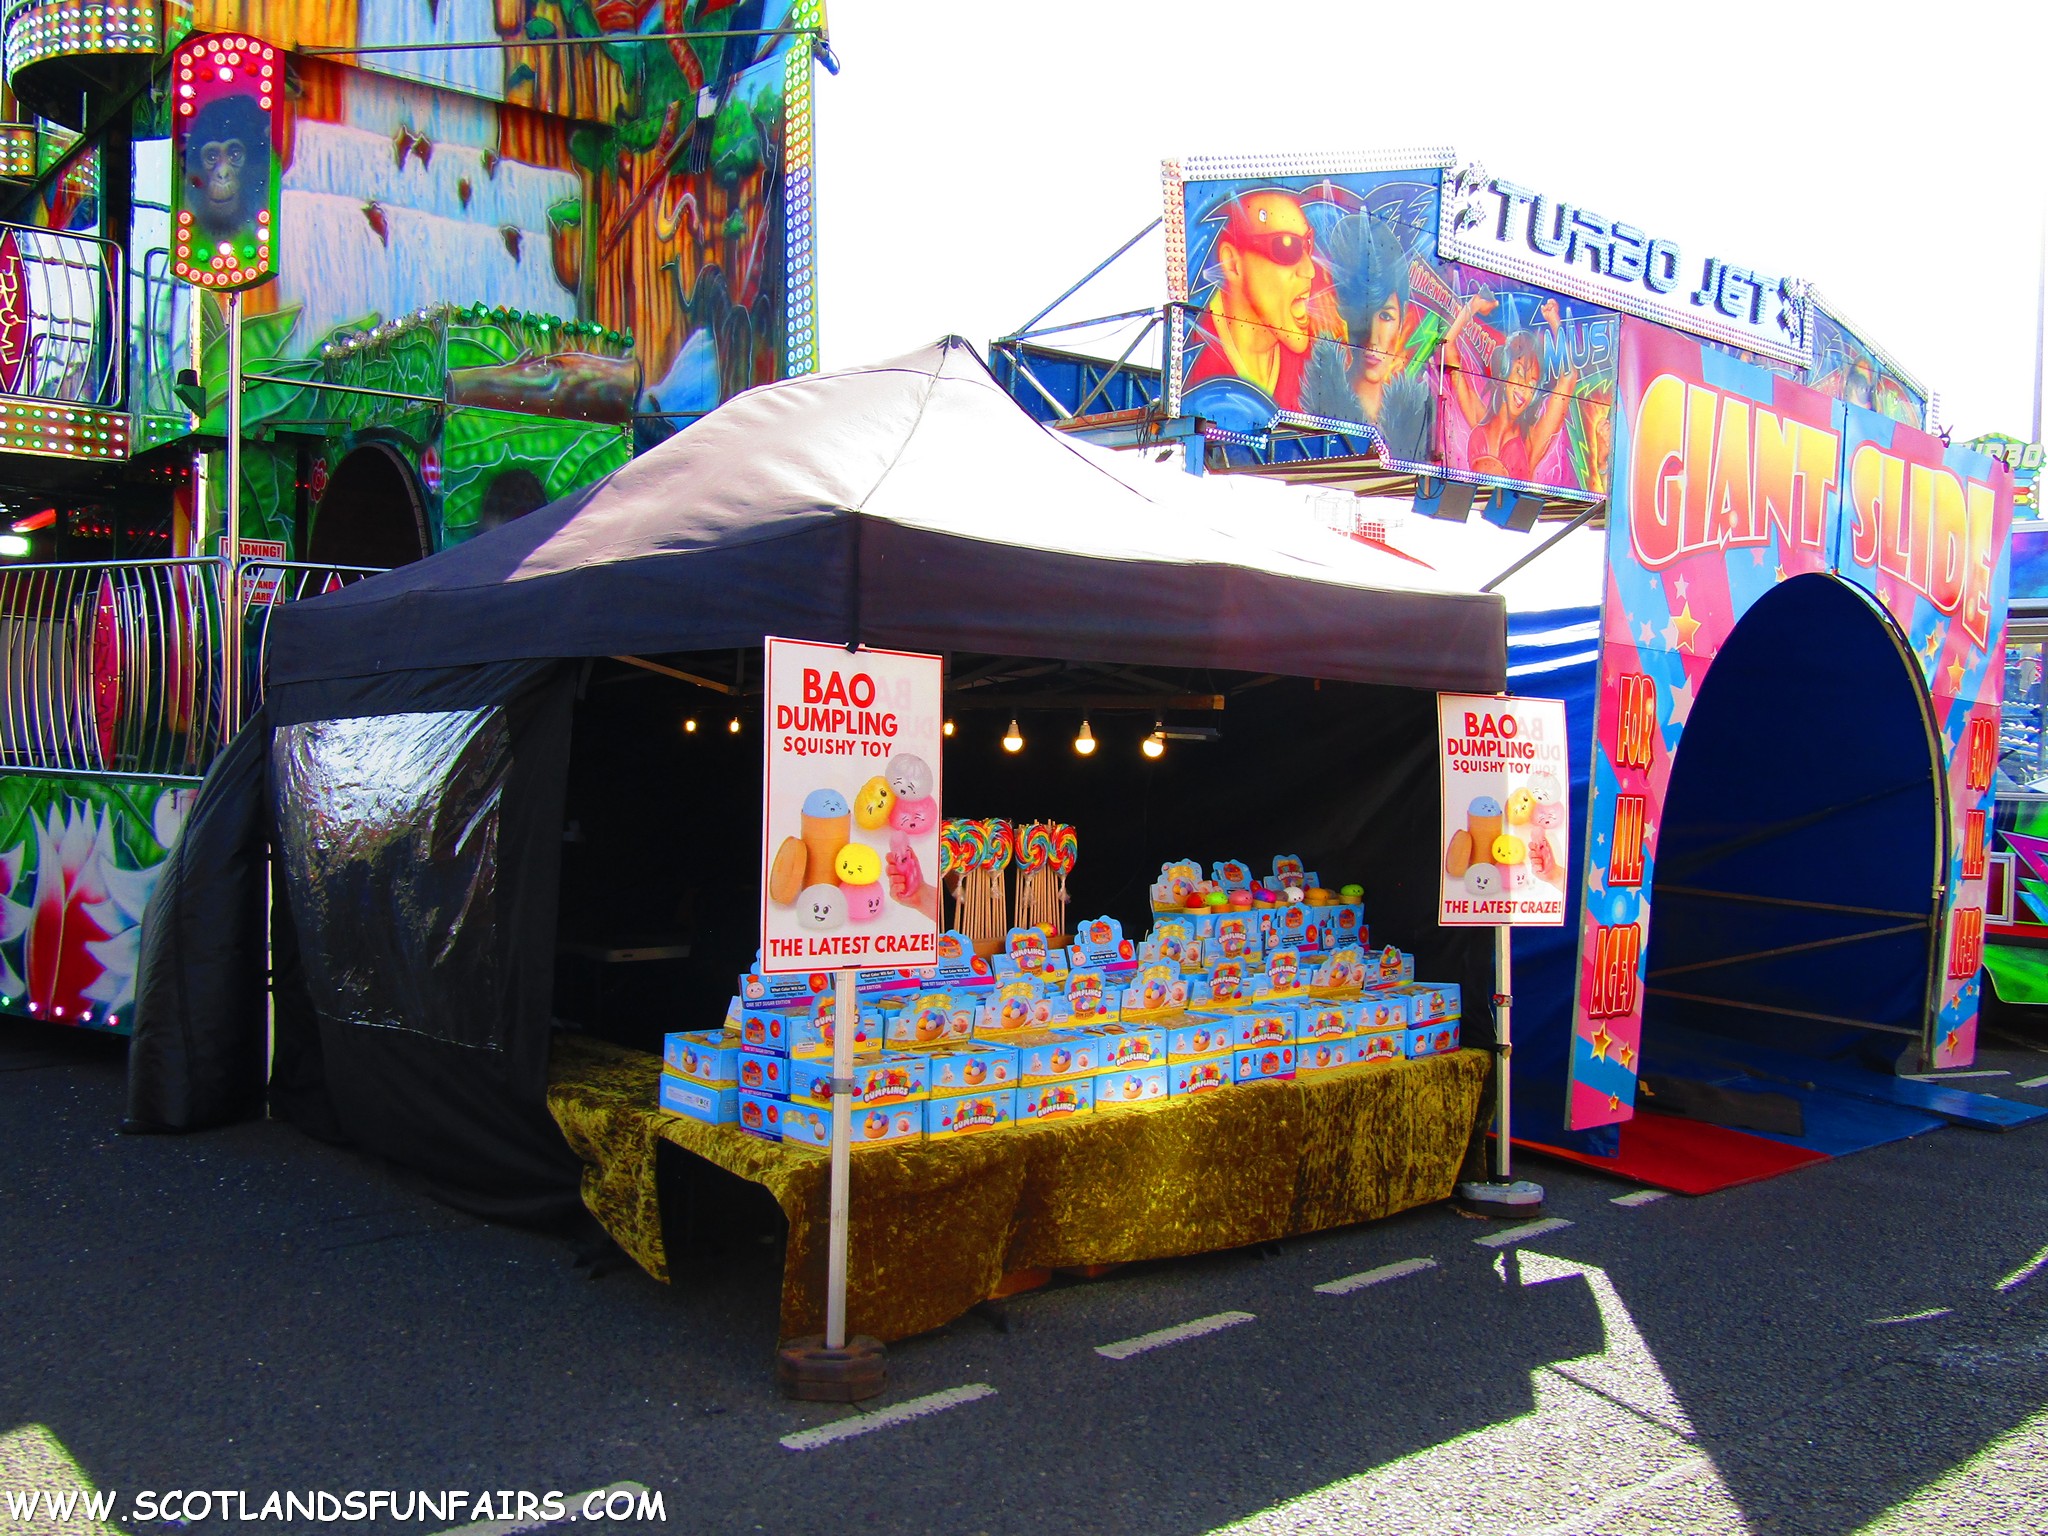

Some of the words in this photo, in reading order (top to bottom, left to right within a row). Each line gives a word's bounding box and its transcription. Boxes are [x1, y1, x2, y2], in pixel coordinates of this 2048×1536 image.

[1489, 177, 1681, 294] TURBO
[1691, 256, 1780, 326] JET
[1629, 372, 1841, 569] GIANT
[1850, 442, 1996, 652] SLIDE
[225, 542, 280, 558] ARNING!
[803, 668, 876, 709] BAO
[777, 704, 898, 738] DUMPLING
[1464, 712, 1518, 739] BAO
[1614, 673, 1656, 772] FOR
[783, 735, 856, 757] SQUISHY
[861, 741, 892, 757] TOY
[1447, 738, 1535, 760] DUMPLING
[1966, 718, 1994, 791] FOR
[1453, 760, 1505, 774] SQUISHY
[1510, 762, 1532, 775] TOY
[1608, 794, 1645, 886] ALL
[1962, 809, 1985, 880] ALL
[1445, 900, 1469, 914] THE
[1472, 901, 1518, 914] LATEST
[1520, 901, 1562, 914] CRAZE!
[769, 938, 803, 957] THE
[808, 935, 871, 956] LATEST
[874, 933, 936, 954] CRAZE!
[1011, 948, 1046, 960] DUMPLINGS
[1948, 907, 1981, 978] AGES
[1589, 924, 1640, 1018] AGES
[1116, 1053, 1151, 1067] DUMPLINGS
[863, 1086, 909, 1103] DUMPLINGS
[953, 1115, 996, 1132] DUMPLINGS
[1037, 1103, 1076, 1119] DUMPLINGS
